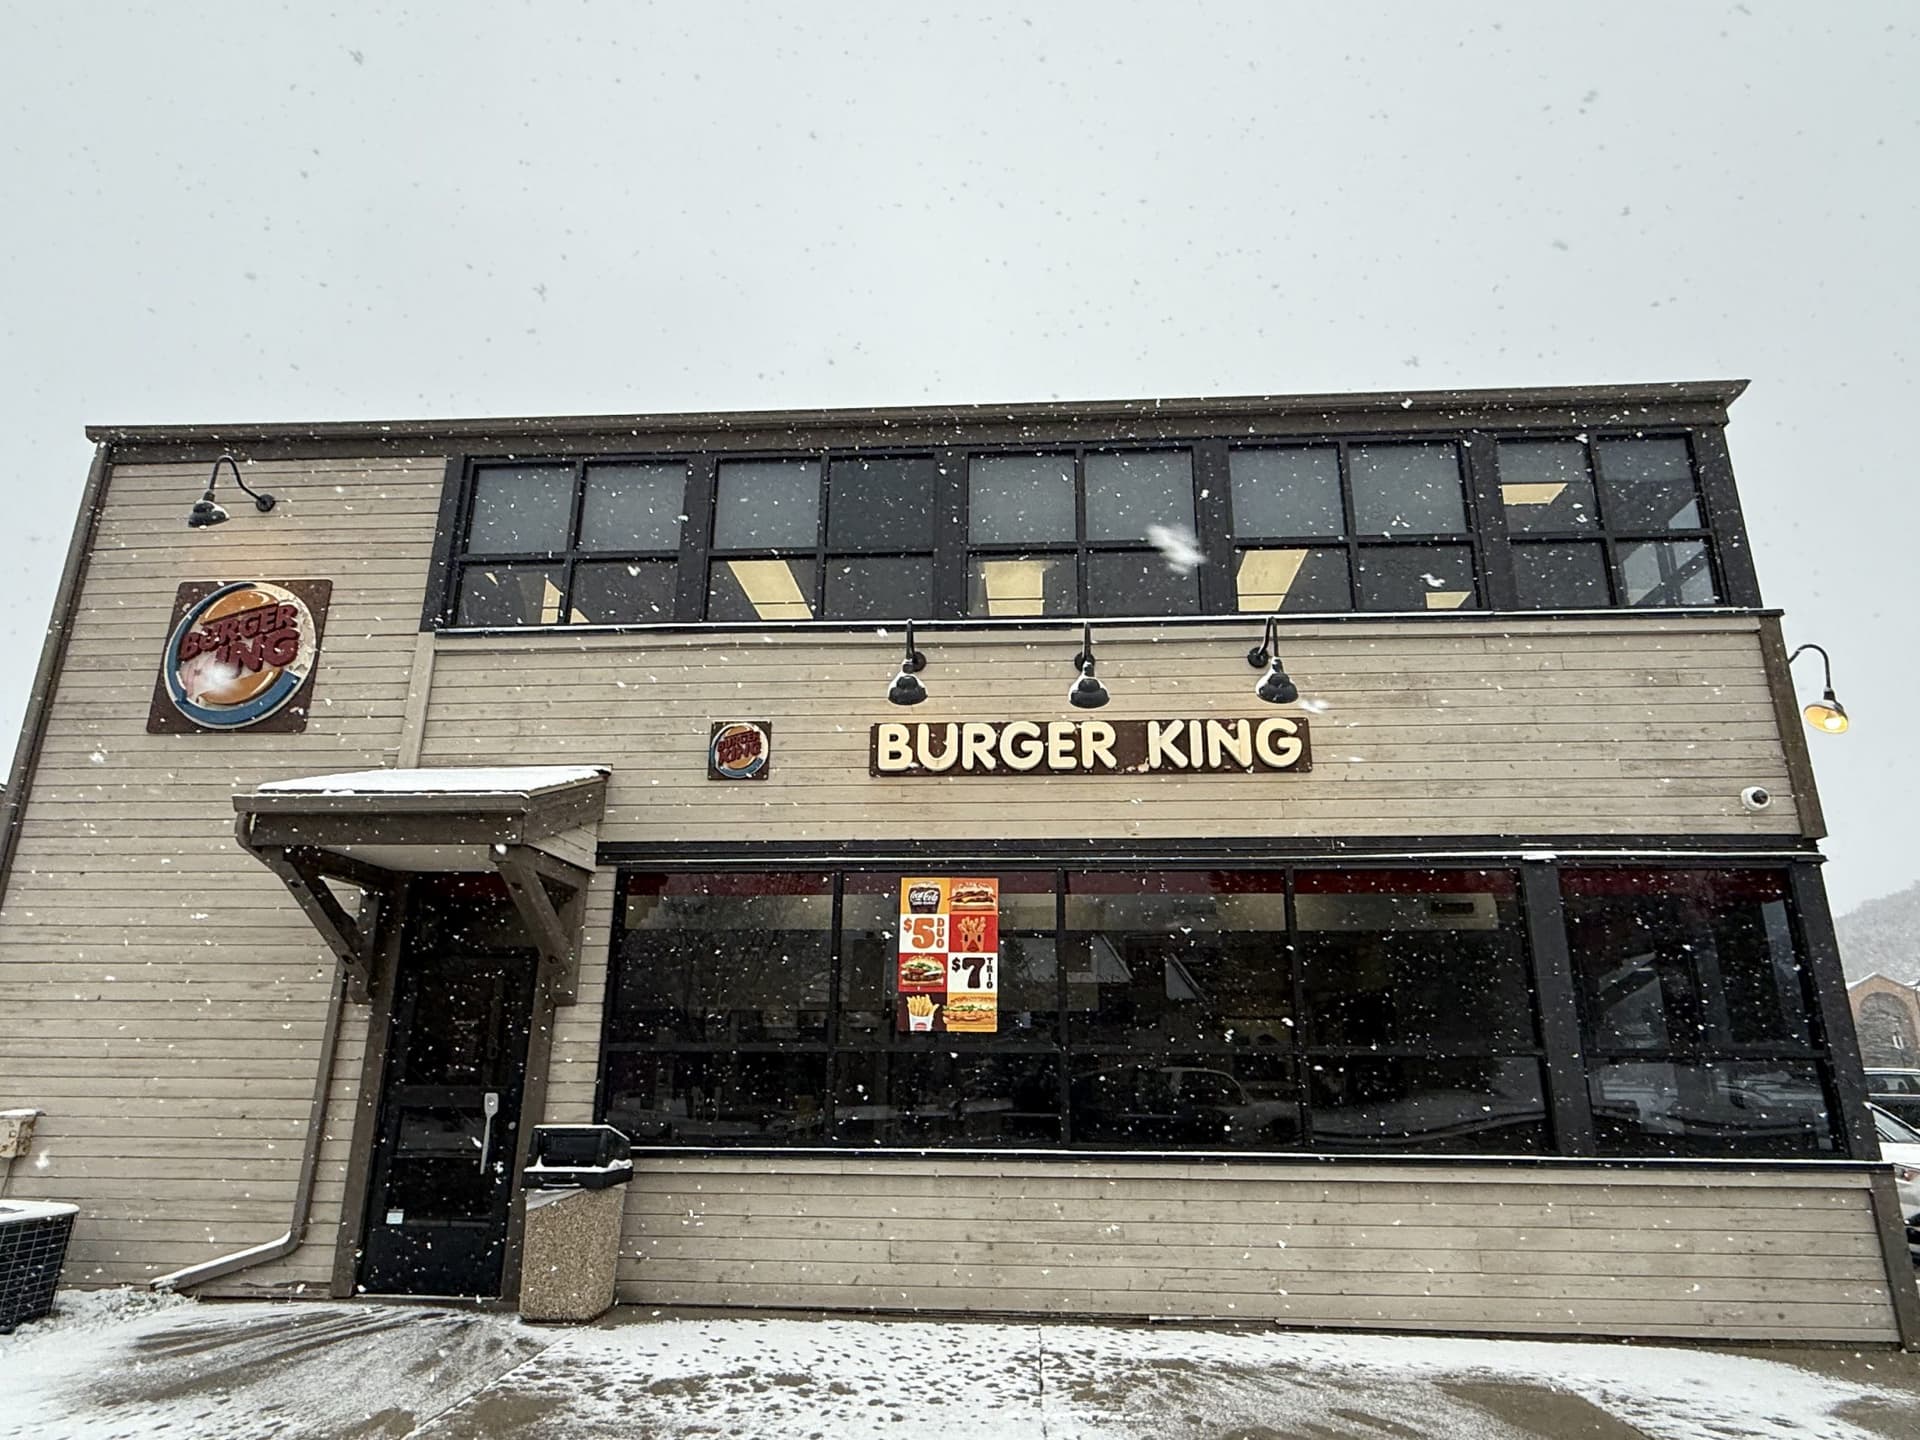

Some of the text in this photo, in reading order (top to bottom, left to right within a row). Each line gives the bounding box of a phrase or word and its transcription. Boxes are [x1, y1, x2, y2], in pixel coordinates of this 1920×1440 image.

[179, 603, 298, 661] BURGER
[718, 741, 762, 765] KING
[876, 717, 1303, 770] BURGER KING
[903, 917, 945, 949] $5 DUO
[951, 957, 994, 989] $7 TRIO
